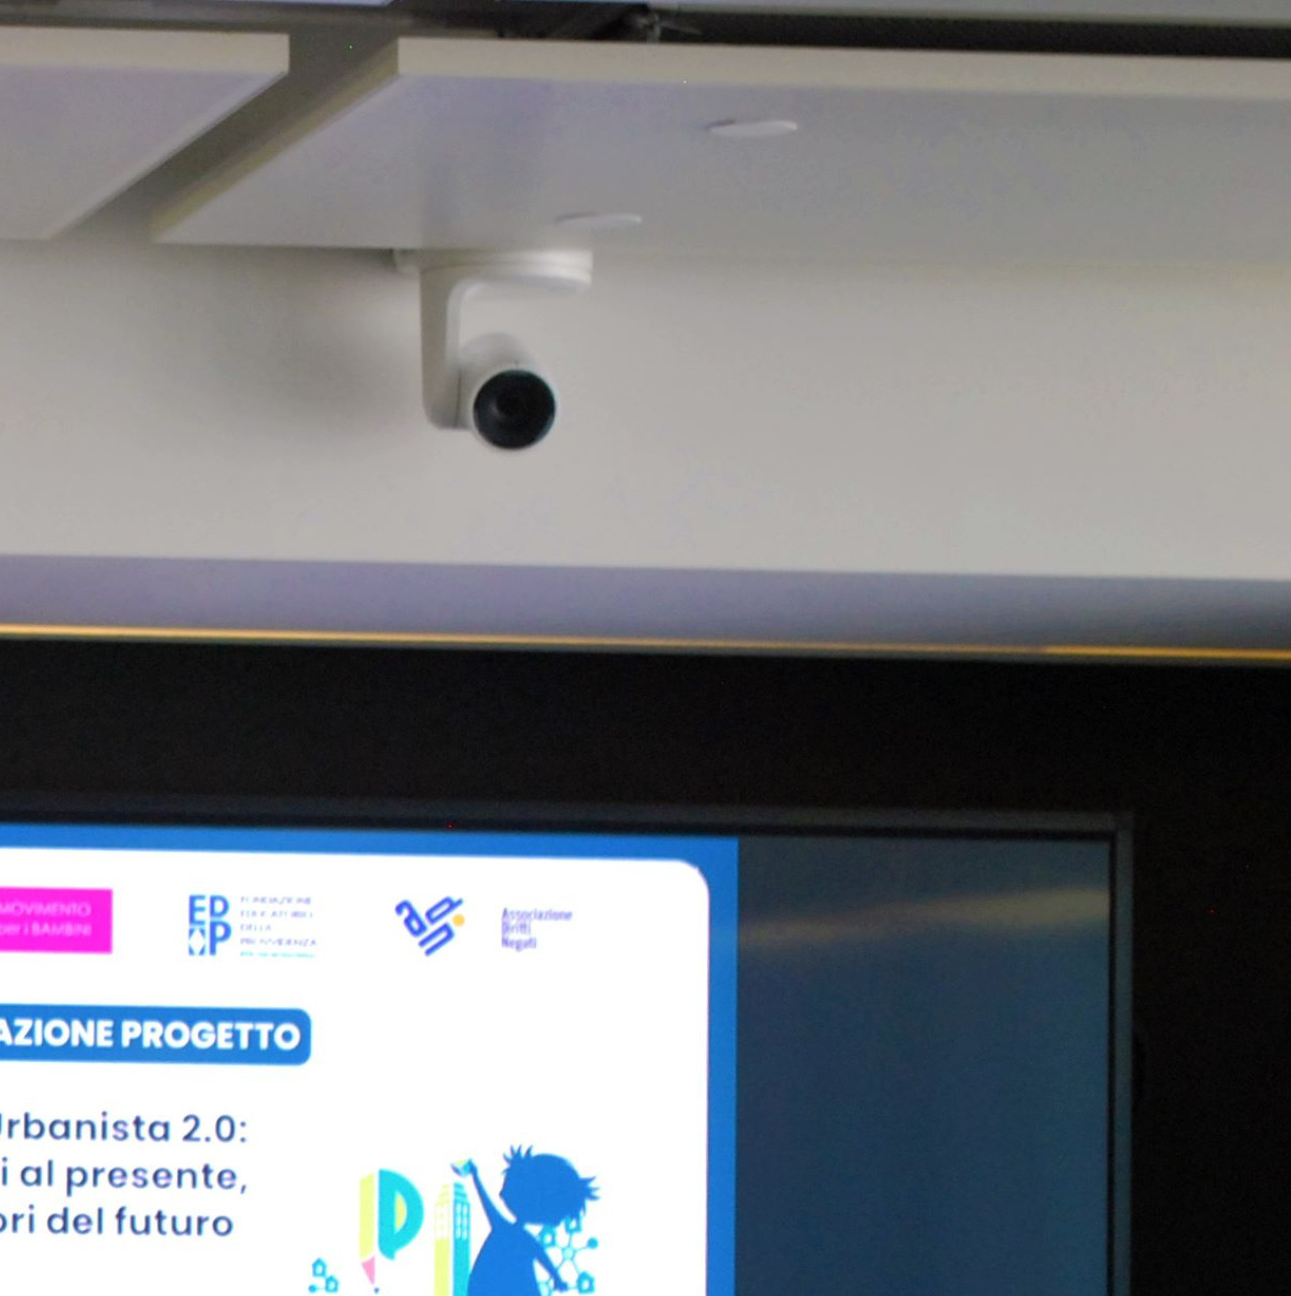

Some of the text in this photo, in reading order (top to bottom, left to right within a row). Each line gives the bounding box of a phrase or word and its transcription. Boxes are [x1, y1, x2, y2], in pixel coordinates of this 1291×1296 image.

[501, 907, 573, 921] Associazione
[32, 922, 92, 937] BAMBINI
[502, 937, 537, 952] Negati
[122, 1021, 301, 1051] PROGETTO
[182, 1114, 247, 1143] 2.0:
[20, 1160, 54, 1187] al
[66, 1163, 247, 1197] presente,
[46, 1207, 104, 1235] del
[114, 1206, 234, 1237] futuro
